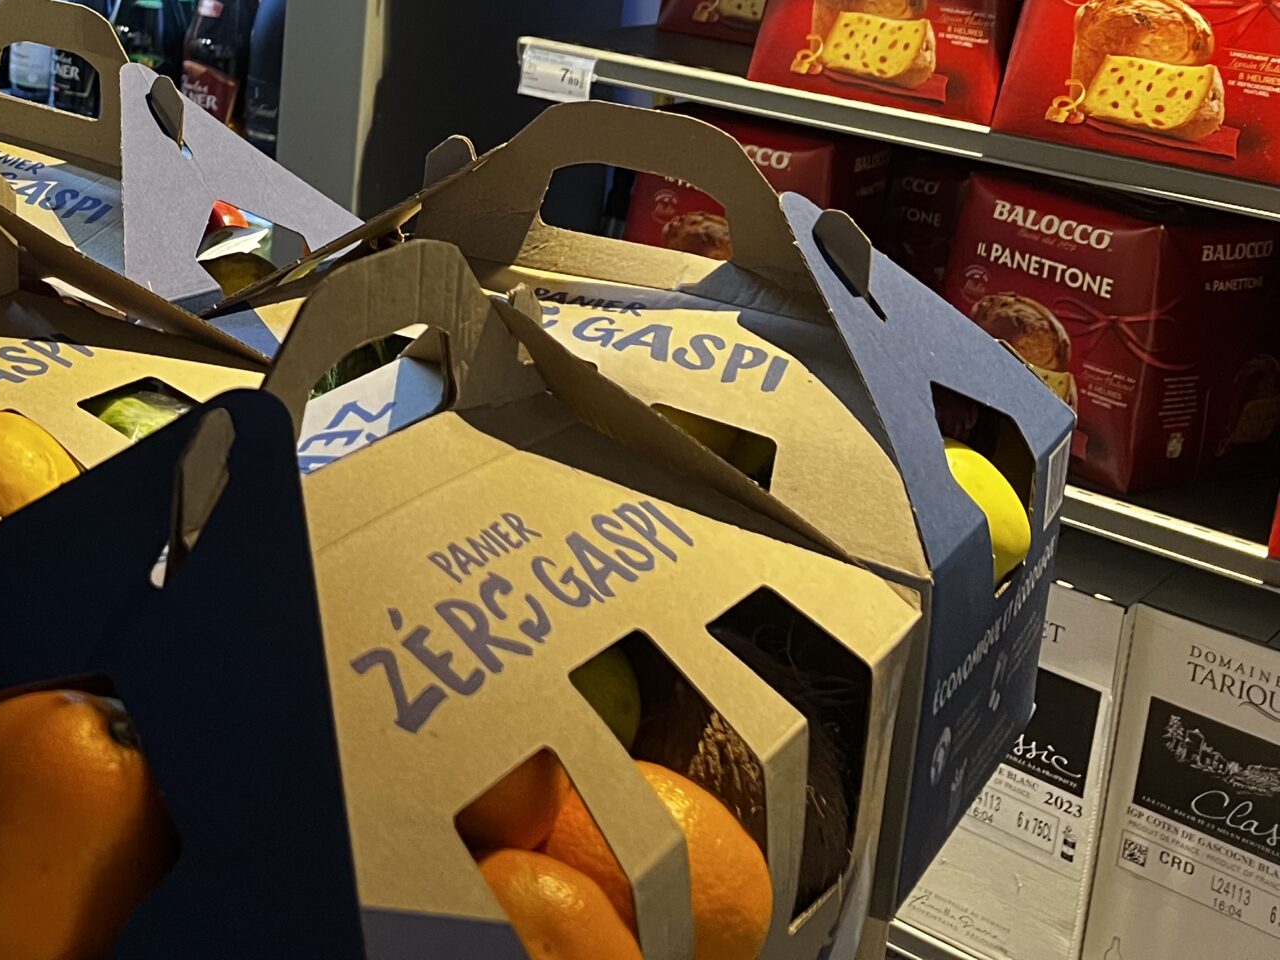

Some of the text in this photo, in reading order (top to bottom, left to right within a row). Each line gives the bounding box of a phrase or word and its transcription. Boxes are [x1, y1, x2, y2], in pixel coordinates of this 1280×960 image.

[992, 199, 1114, 250] BALOCCO
[977, 242, 1115, 299] IL PANETTONE
[1201, 240, 1273, 262] BALOCCO
[535, 287, 647, 317] PANIER
[572, 316, 790, 393] GASPI
[427, 512, 544, 584] PANIER
[531, 499, 696, 609] GASPI
[1043, 791, 1084, 819] 2023
[1158, 849, 1196, 877] CRD
[1197, 832, 1256, 867] GASCOGNE
